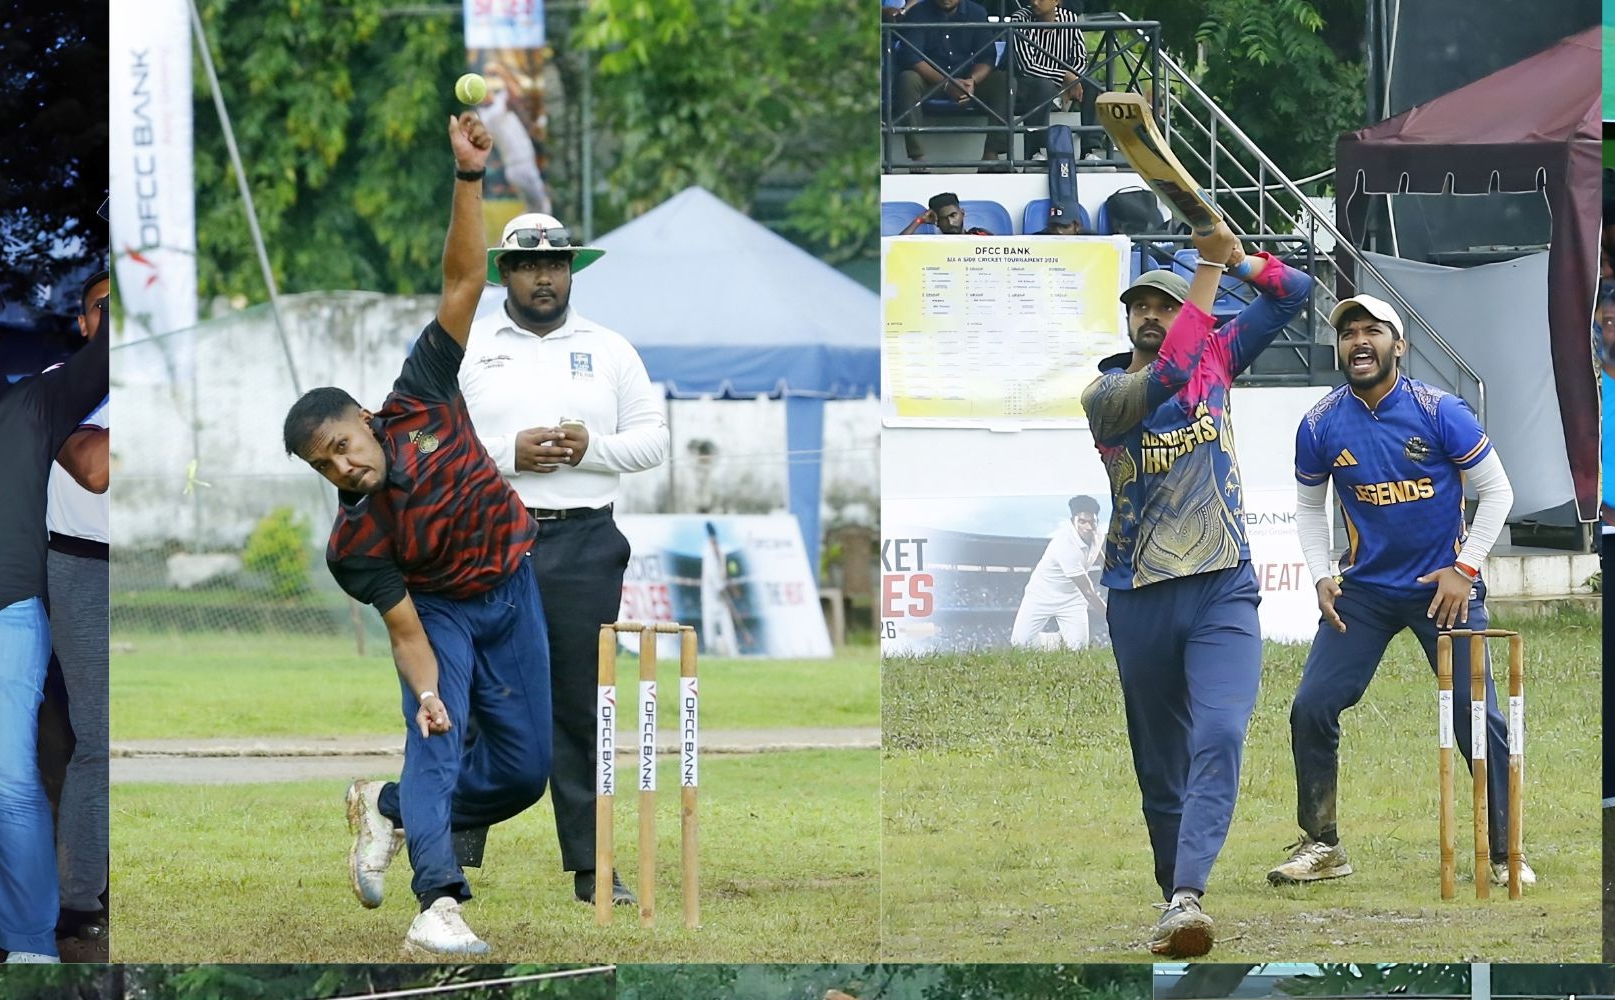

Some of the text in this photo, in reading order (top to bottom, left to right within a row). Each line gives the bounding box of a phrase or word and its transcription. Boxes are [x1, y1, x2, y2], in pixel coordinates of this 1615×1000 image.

[130, 48, 161, 249] DFCC BANK
[975, 247, 1031, 256] DFCC BANK
[1246, 511, 1298, 525] BANK
[602, 706, 612, 794] DFCC BANK
[642, 701, 655, 790] DFCC BANK
[684, 697, 695, 786] DFCC BANK
